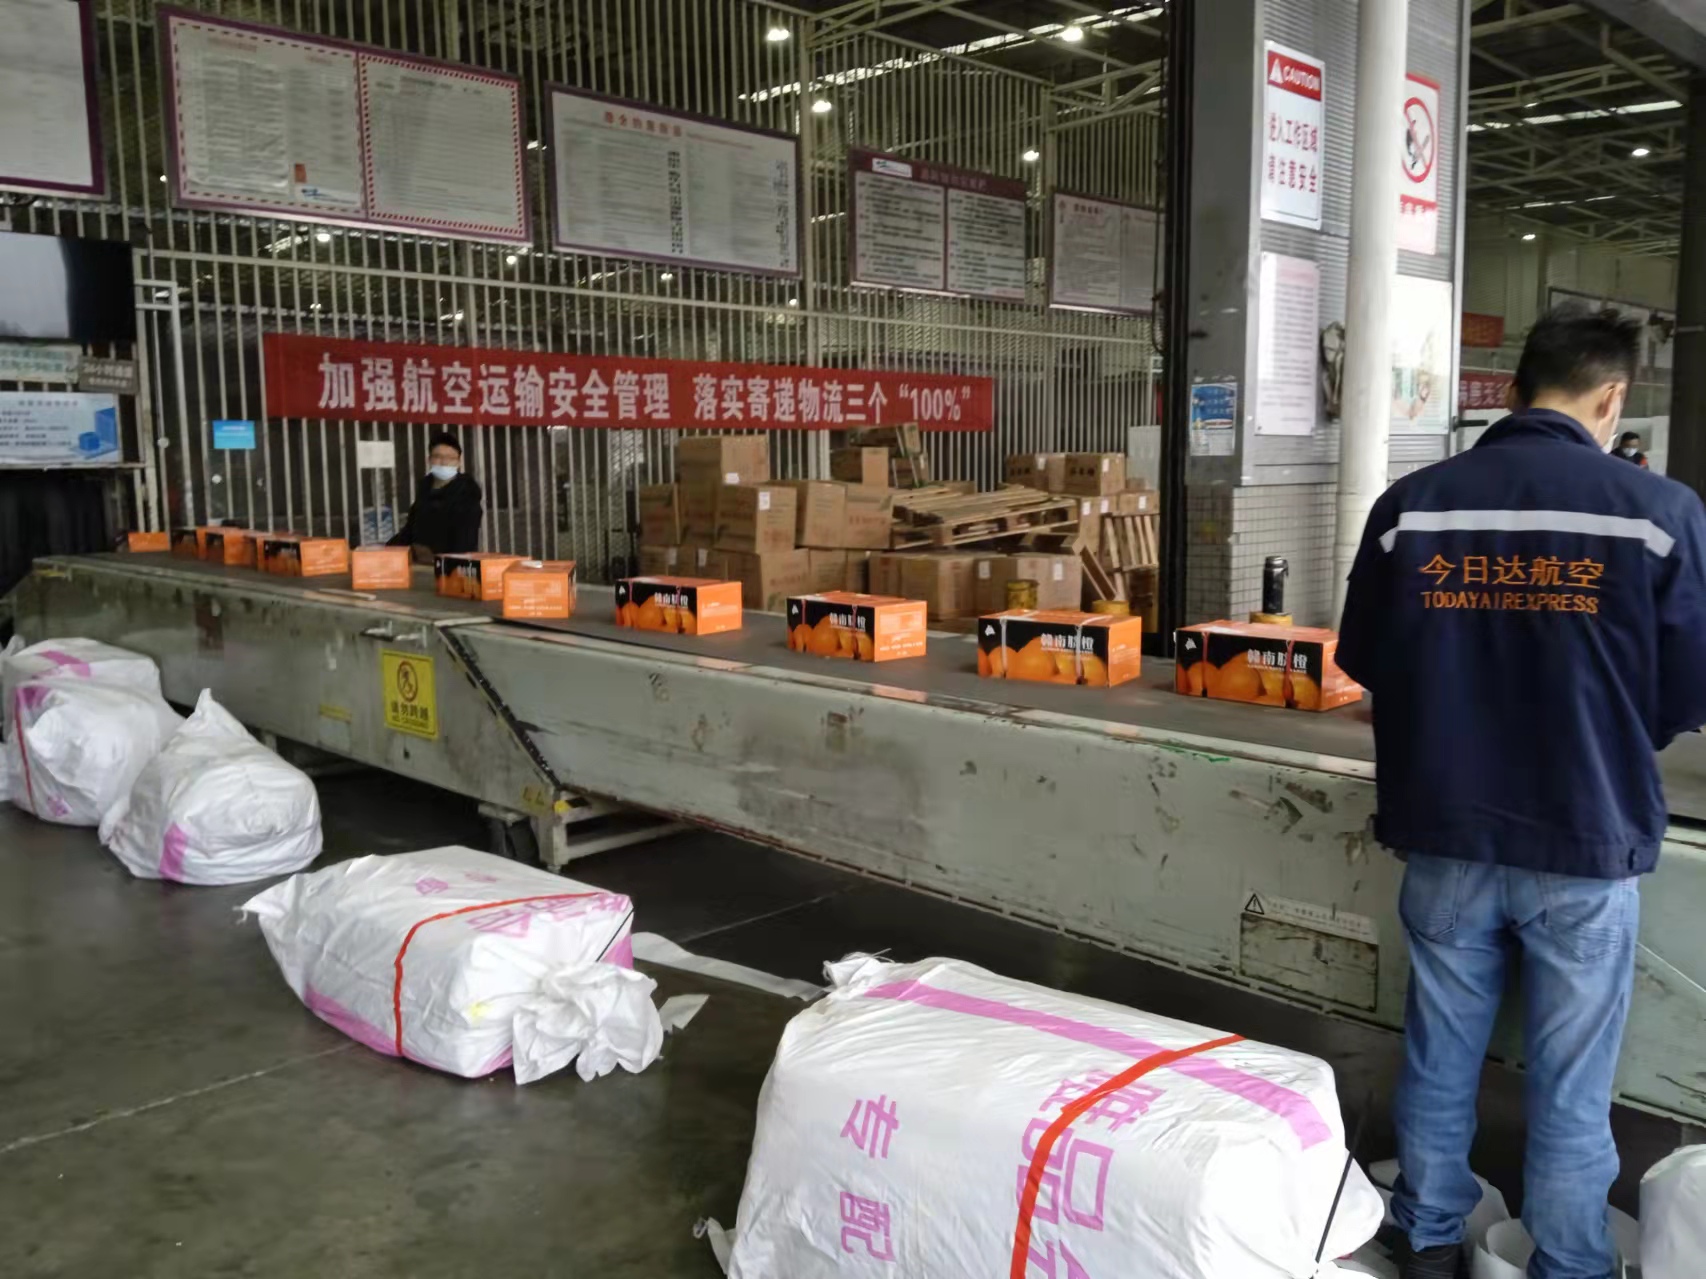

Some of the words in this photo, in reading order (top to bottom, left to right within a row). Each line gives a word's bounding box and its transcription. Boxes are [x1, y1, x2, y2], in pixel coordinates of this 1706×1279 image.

[1283, 65, 1321, 92] CAUTION
[1267, 155, 1318, 193] 请注意安全
[318, 352, 672, 420] 加强航空运输安全管理
[1419, 554, 1604, 589] 今日达航空
